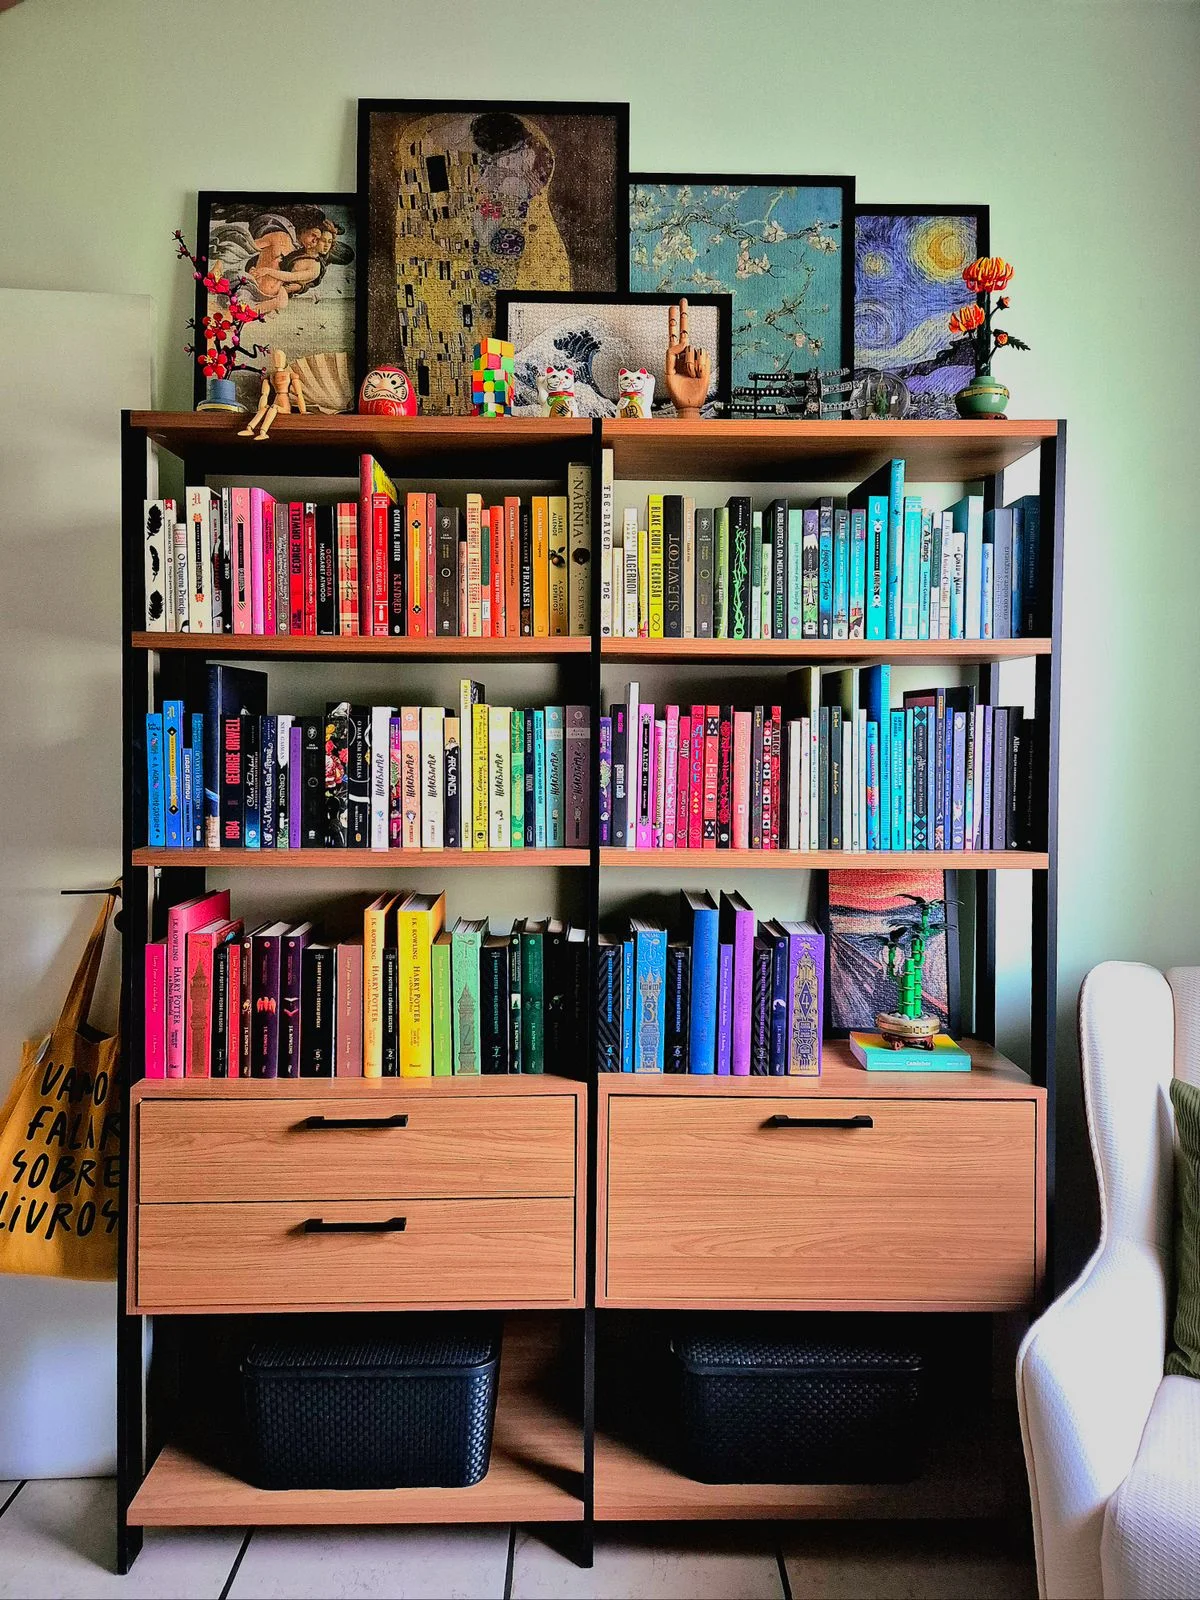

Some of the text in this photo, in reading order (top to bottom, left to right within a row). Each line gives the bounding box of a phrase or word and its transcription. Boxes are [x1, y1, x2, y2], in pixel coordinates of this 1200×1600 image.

[468, 508, 479, 548] BLAKE CROUCH
[572, 480, 588, 538] NÁRNIA
[292, 509, 301, 574] GEORGE ORWELL
[651, 506, 661, 554] BLAKE CROUCH
[177, 562, 186, 588] Pequeno
[626, 554, 636, 595] ALGERNON
[651, 563, 662, 598] RECURSÃO
[667, 534, 680, 611] SLEWFOOT
[822, 580, 831, 600] FAUNO
[177, 590, 186, 615] Príncipe
[393, 574, 402, 614] KINDRED
[469, 584, 479, 604] ESCURA
[680, 740, 689, 758] Alice
[772, 728, 780, 756] ALICE
[225, 718, 240, 839] GEORGE ORWELL 1984
[376, 753, 385, 797] HEARTSTOPPER
[406, 754, 416, 797] HEARTSTOPPER
[428, 754, 437, 797] HEARTSTOPPER
[448, 756, 456, 796] ARCANOS
[495, 753, 504, 797] HEARTSTOPPER
[550, 753, 560, 796] HEARTSTOPPER
[573, 751, 582, 794] HEARTSTOPPER
[916, 755, 926, 771] Alice
[173, 967, 182, 1024] HARRY POTTER
[644, 1002, 654, 1022] 3
[801, 993, 810, 1009] 4
[12, 1149, 120, 1197] SOBRE
